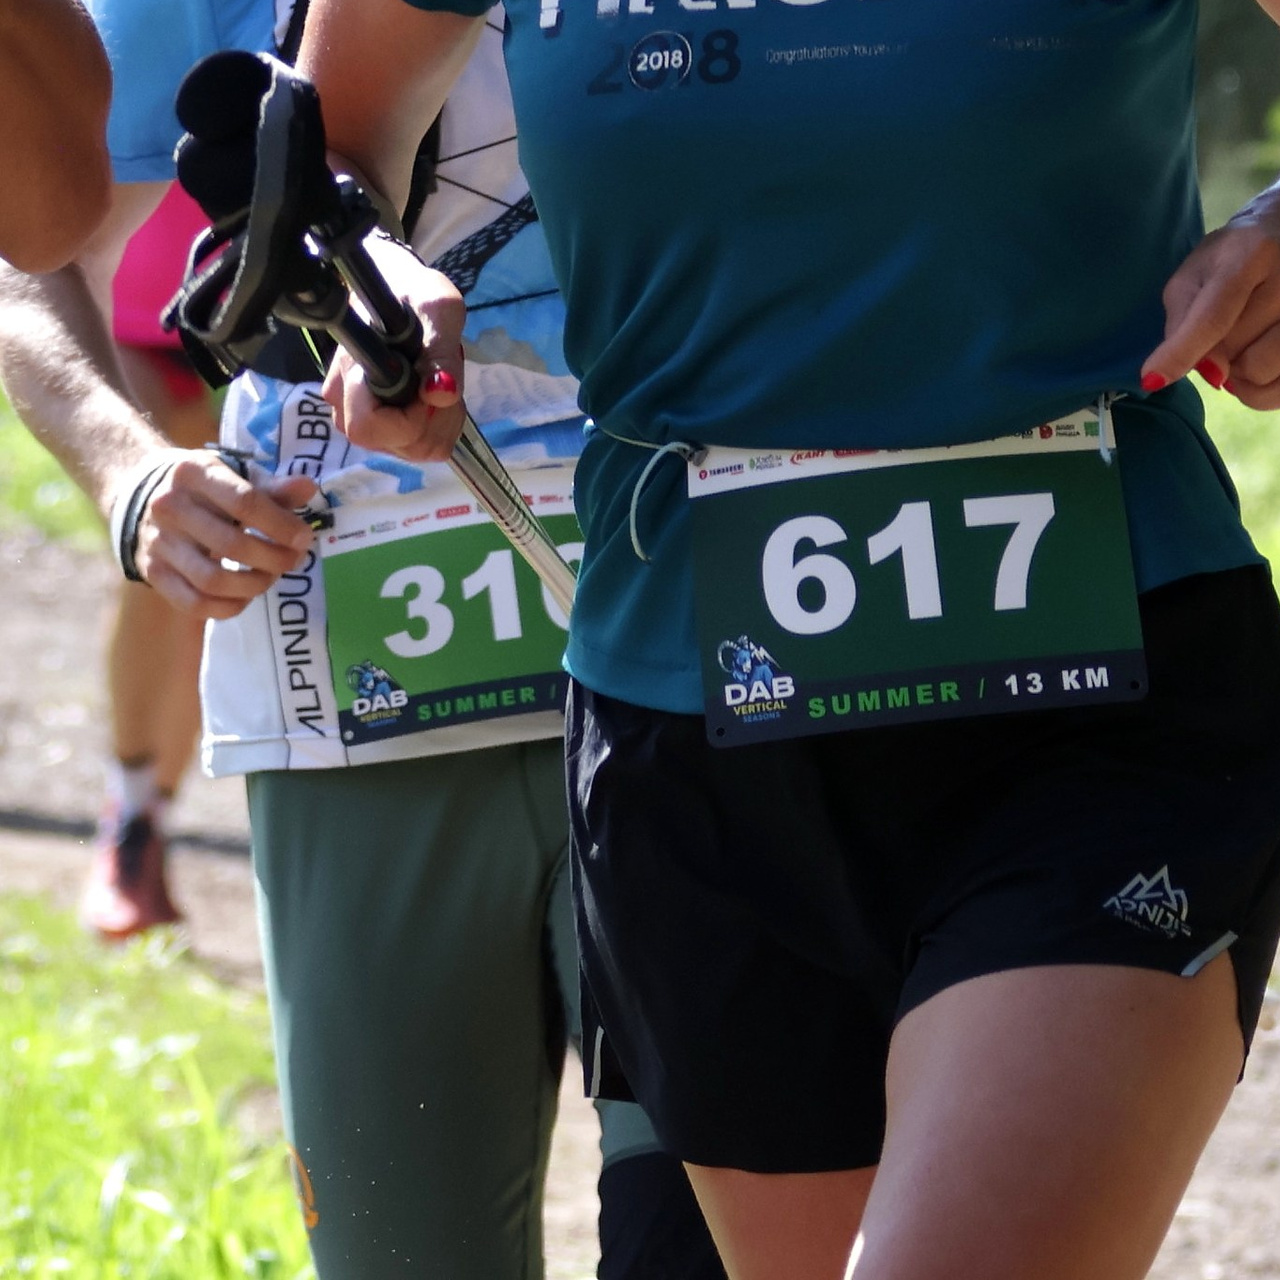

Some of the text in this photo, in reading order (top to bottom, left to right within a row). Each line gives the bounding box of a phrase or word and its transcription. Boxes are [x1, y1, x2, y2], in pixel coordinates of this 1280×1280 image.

[636, 49, 683, 72] 2018
[762, 492, 1056, 635] 617
[352, 689, 409, 717] DAB
[419, 686, 536, 720] SUMMER
[724, 676, 796, 707] DAB
[808, 681, 960, 718] SUMMER
[1005, 673, 1044, 696] 13
[1062, 666, 1110, 691] KM
[733, 699, 788, 716] VERTICAL
